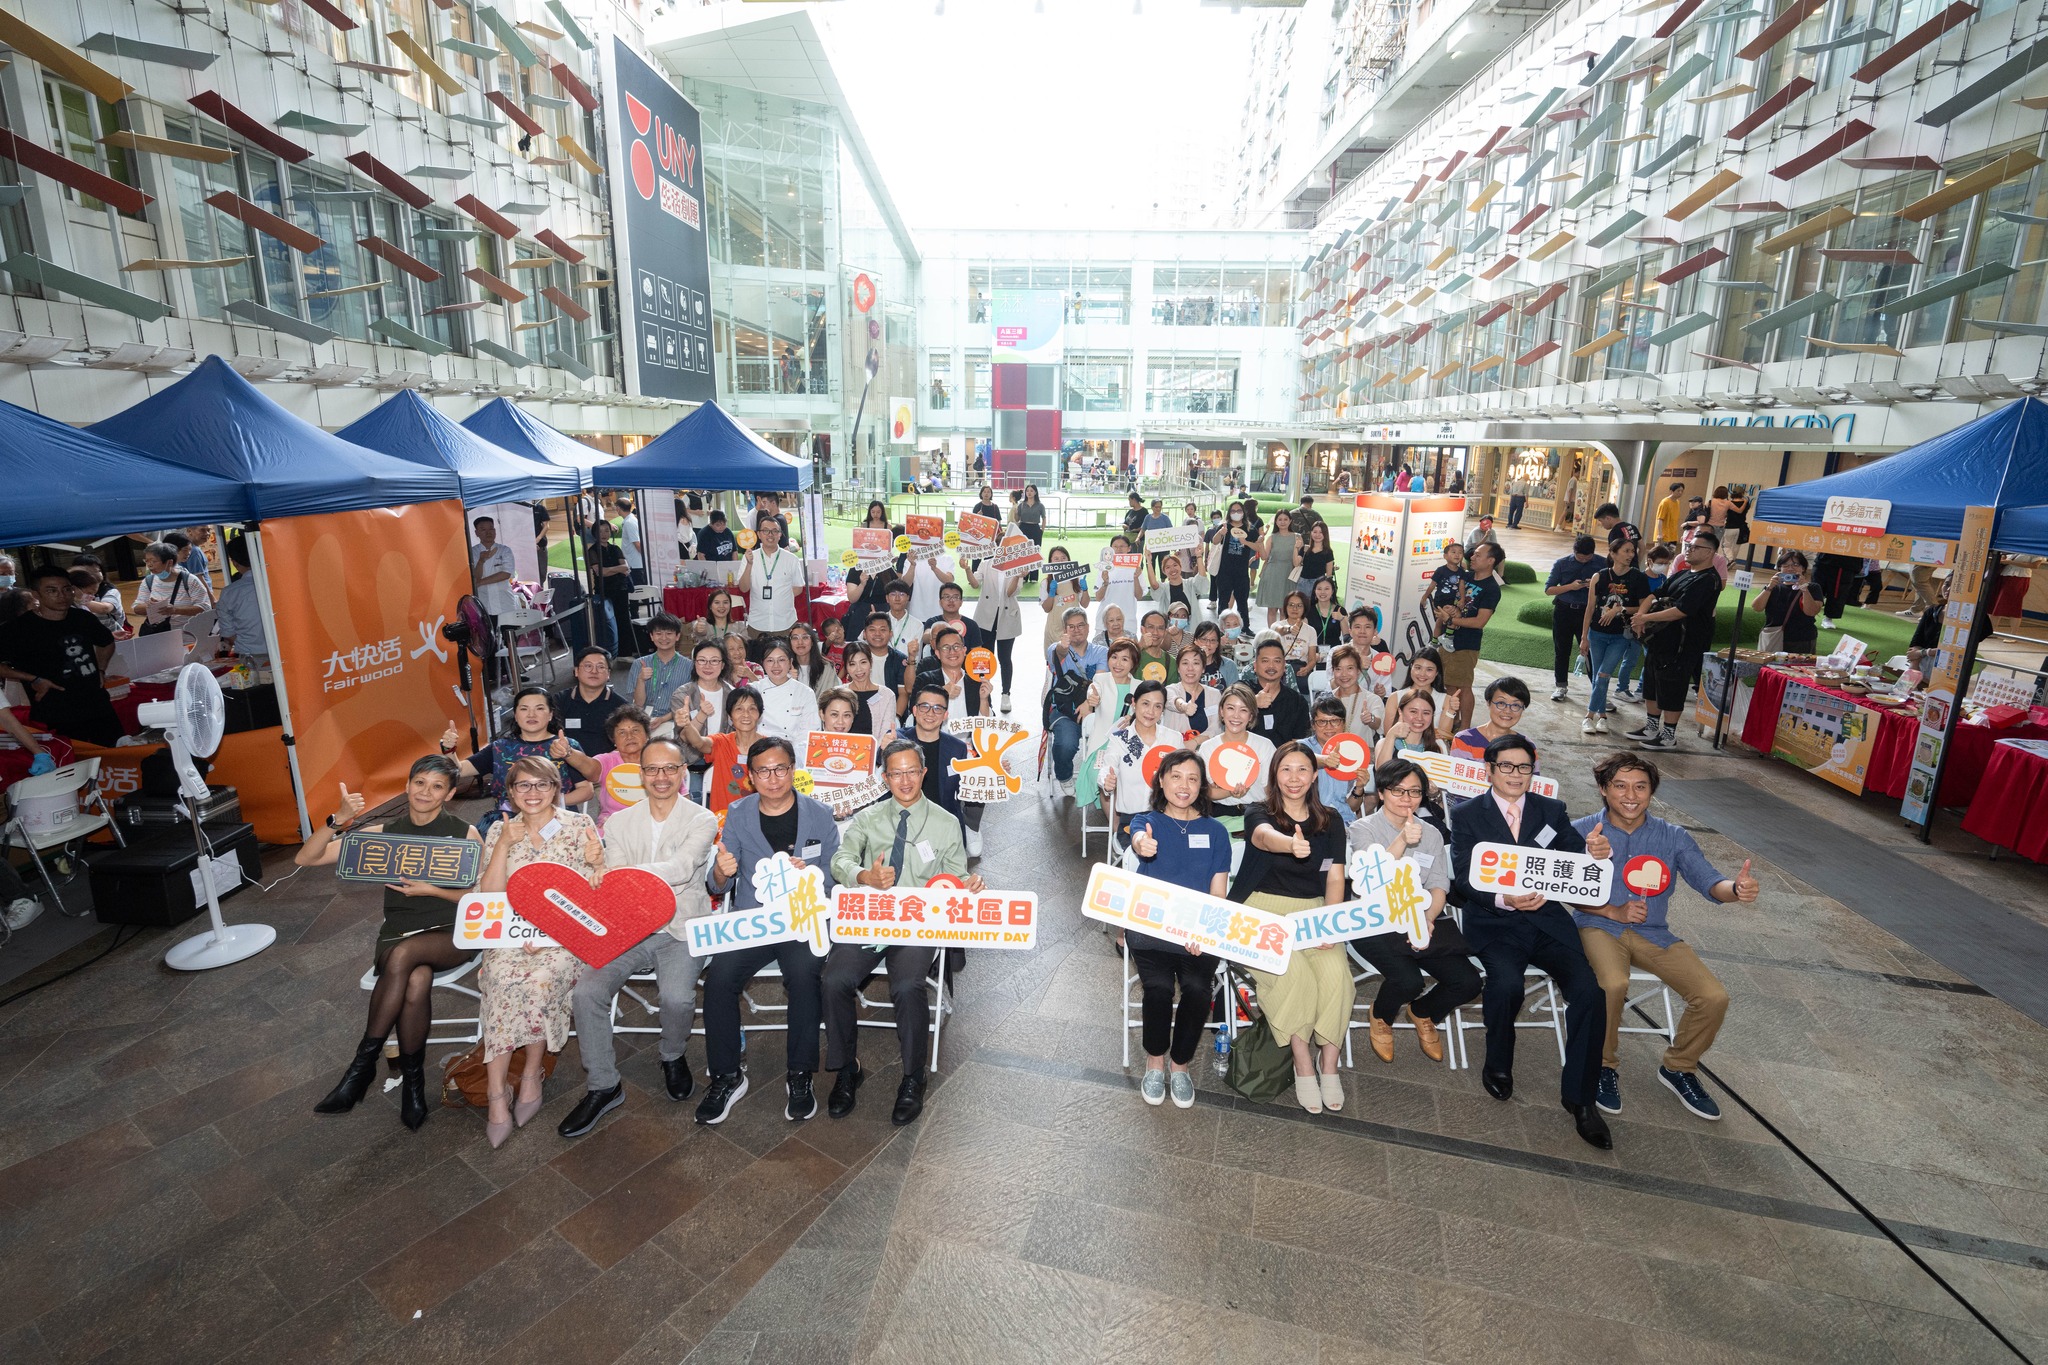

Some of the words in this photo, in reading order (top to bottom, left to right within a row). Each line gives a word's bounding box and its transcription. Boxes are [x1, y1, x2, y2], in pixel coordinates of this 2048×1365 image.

[655, 116, 695, 188] UNY
[1844, 502, 1883, 520] 幸福元氣
[1148, 532, 1197, 546] COOKEASY
[1045, 563, 1076, 571] PROJECT
[1058, 567, 1087, 580] FUTURUS
[322, 635, 401, 678] 大快活
[323, 662, 403, 693] Fairwood
[1200, 670, 1224, 682] ardi
[950, 718, 1021, 733] 快活回味軟餐
[832, 738, 849, 747] 快活
[961, 775, 1006, 787] 10月1日
[1452, 782, 1467, 792] Care
[1468, 785, 1485, 795] Food
[960, 788, 1007, 800] 正式推出
[357, 840, 462, 880] 食得喜
[1524, 855, 1604, 883] 照護食
[1522, 877, 1600, 898] CareFood
[693, 911, 786, 948] HKCSS
[1295, 903, 1385, 942] HKCSS
[836, 926, 869, 937] CARE
[874, 927, 911, 938] FOOD
[917, 929, 1000, 942] COMMUNITY
[1003, 932, 1030, 942] DAY
[1165, 925, 1189, 939] CARE
[1190, 933, 1216, 947] FOOD
[1218, 942, 1260, 960] AROUND
[1262, 954, 1282, 967] YOU
